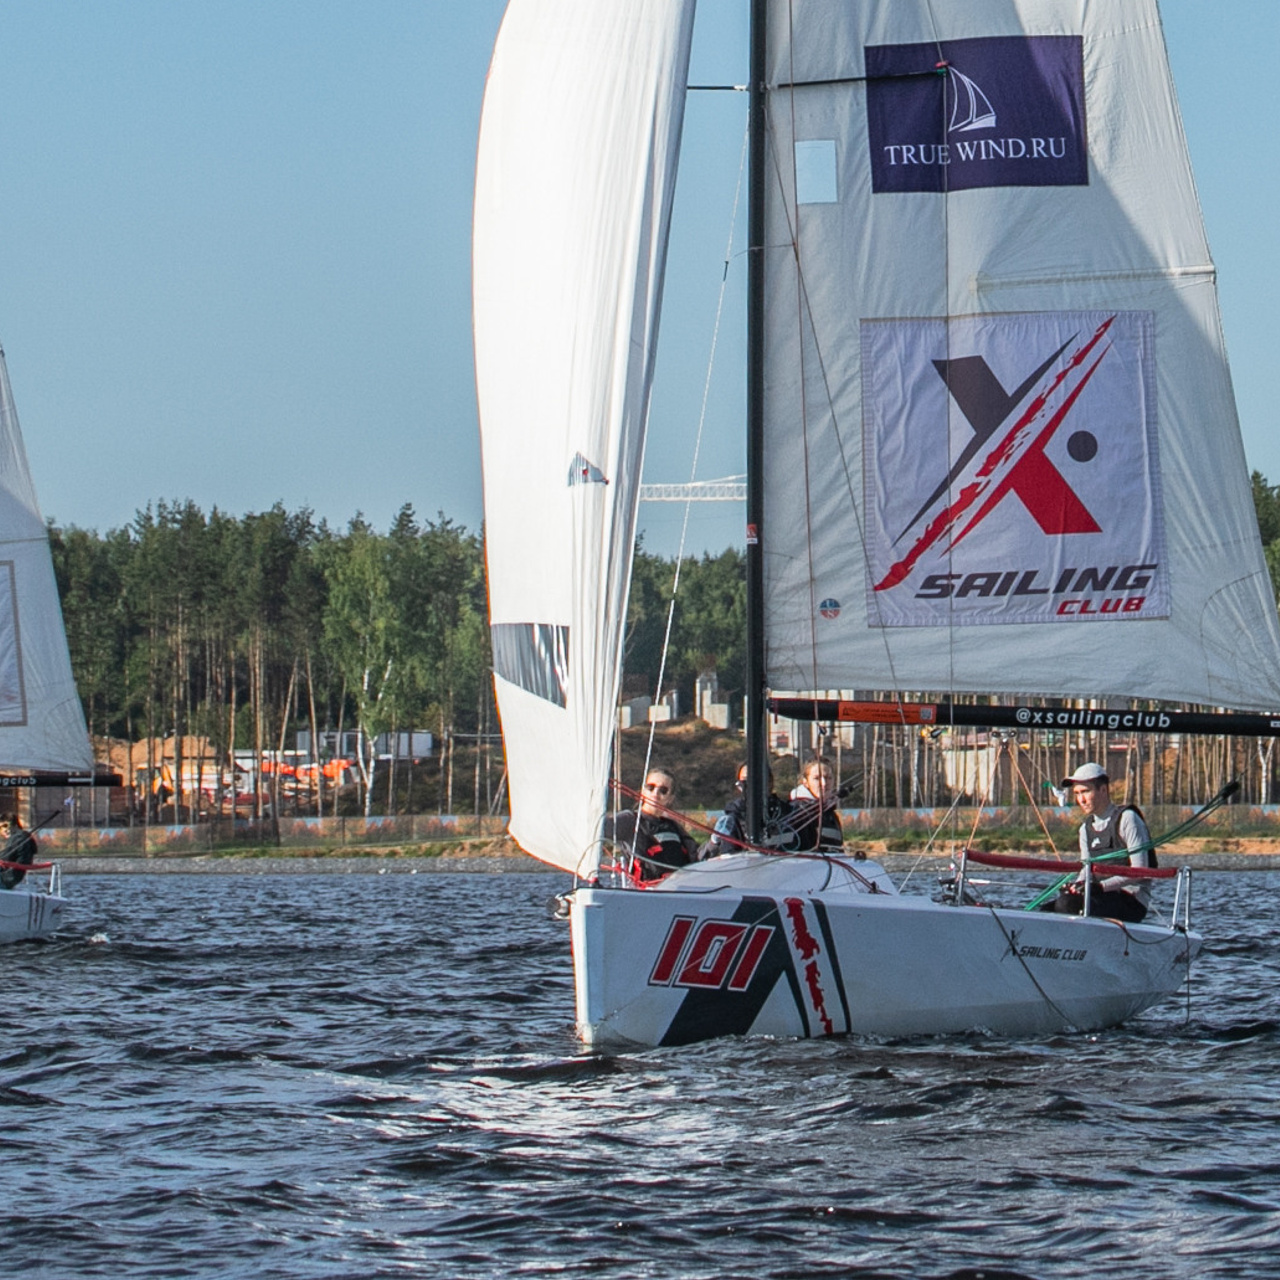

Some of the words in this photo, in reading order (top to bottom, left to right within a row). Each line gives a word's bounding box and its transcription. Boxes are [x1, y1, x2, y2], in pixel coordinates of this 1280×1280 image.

[884, 144, 951, 166] TRUE
[955, 137, 1066, 163] WIND.RU
[914, 564, 1158, 600] SAILING
[1056, 596, 1146, 616] CLUB
[1015, 707, 1171, 729] @xsailingclub
[647, 914, 776, 992] 101
[1020, 945, 1062, 960] SAILING
[1061, 948, 1088, 961] CLUB
